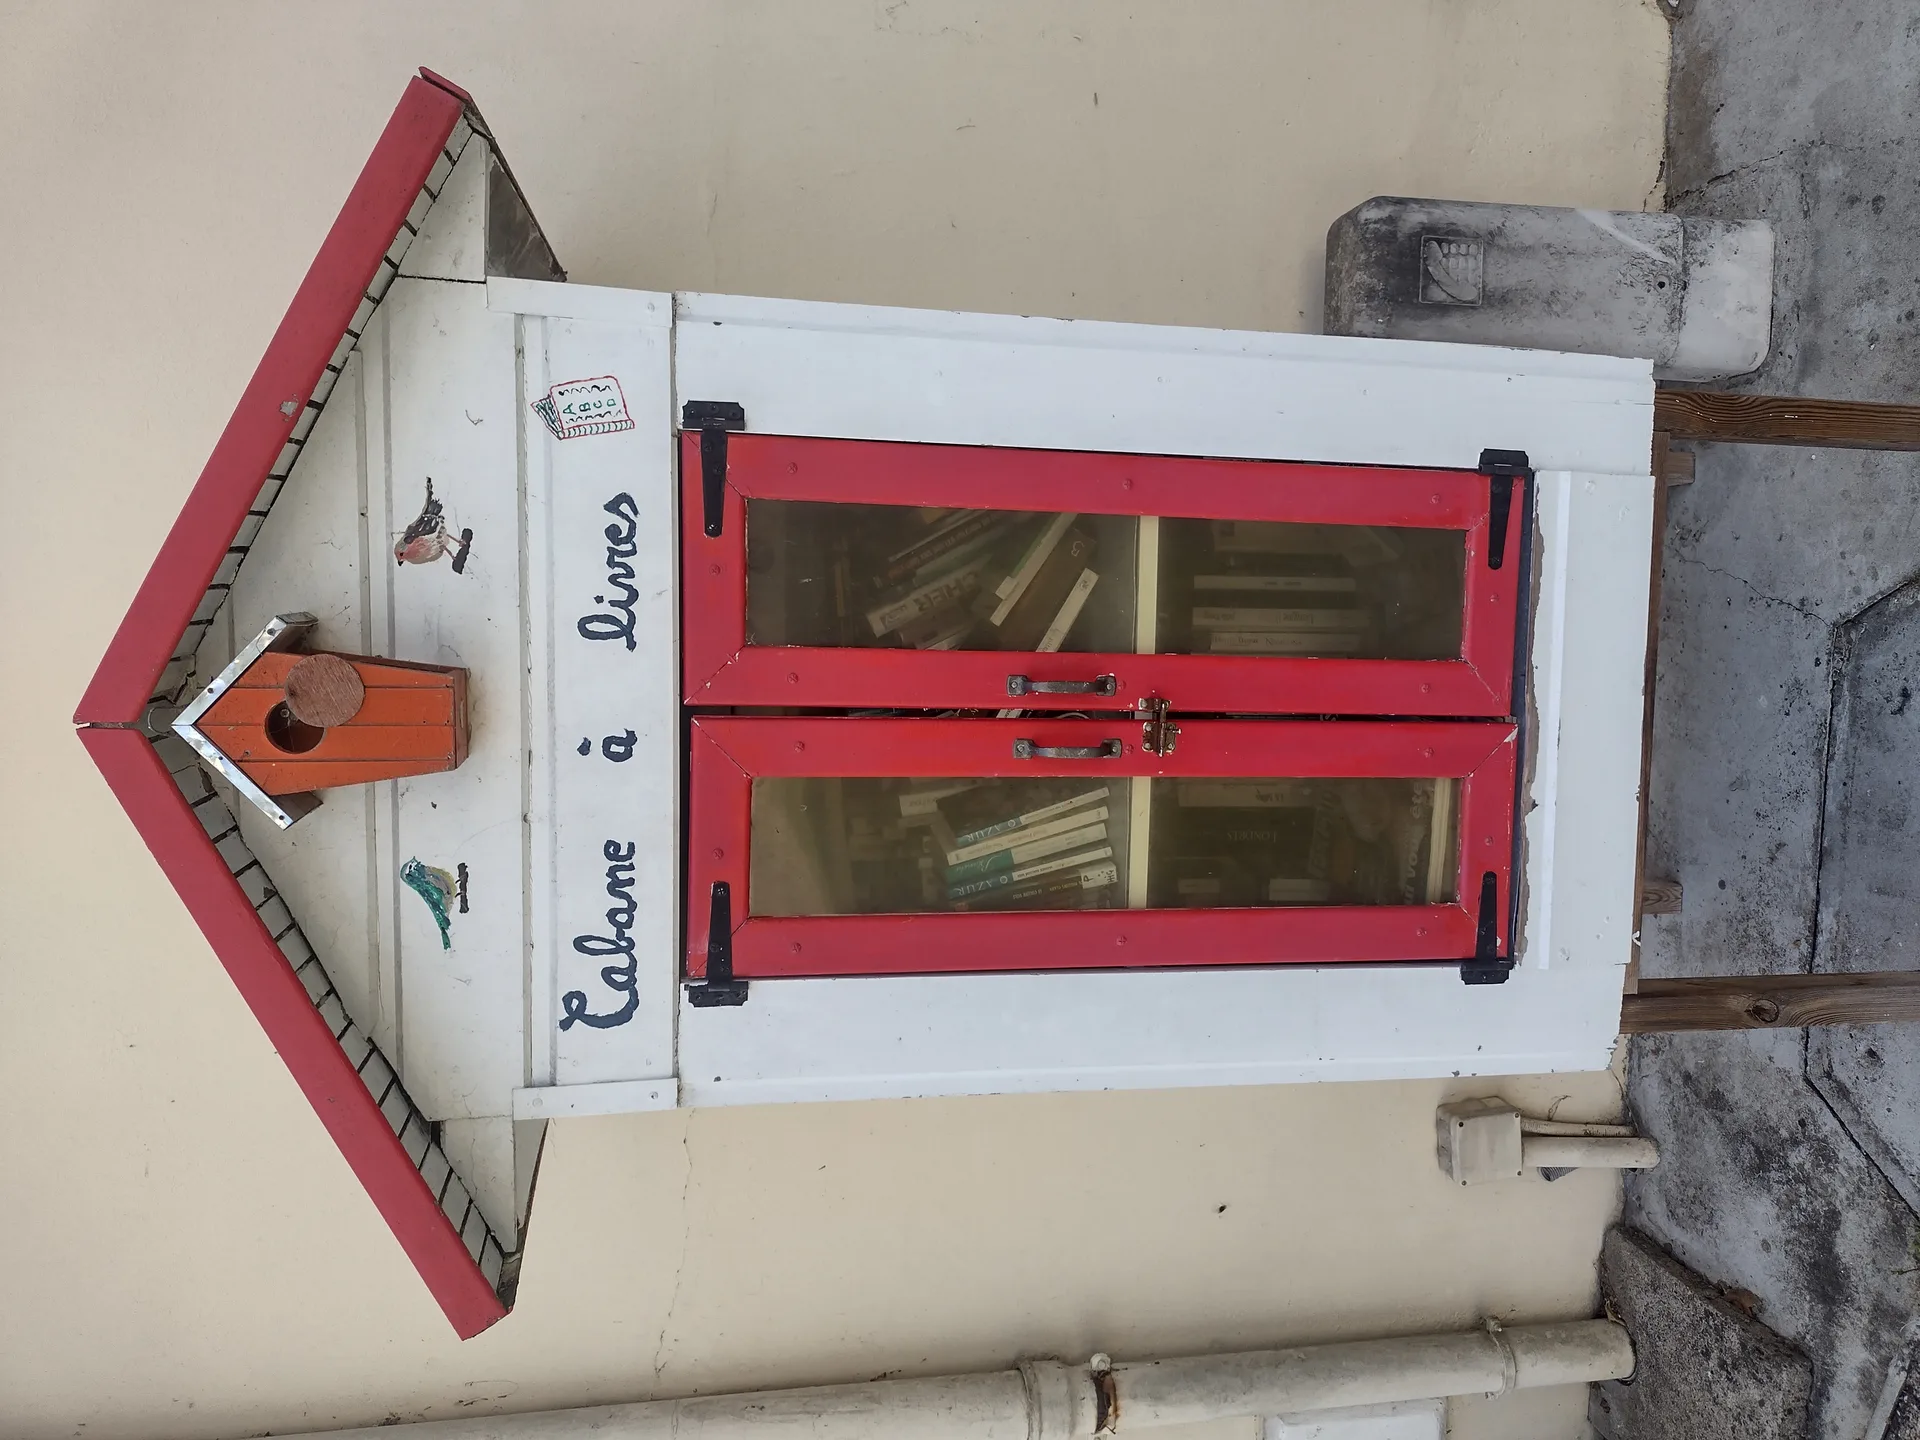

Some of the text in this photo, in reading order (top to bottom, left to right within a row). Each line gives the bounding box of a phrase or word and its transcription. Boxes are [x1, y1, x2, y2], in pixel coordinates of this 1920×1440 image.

[559, 493, 639, 1032] Cabane à livres
[967, 824, 1001, 842] AZUR
[953, 880, 994, 897] AZUR
